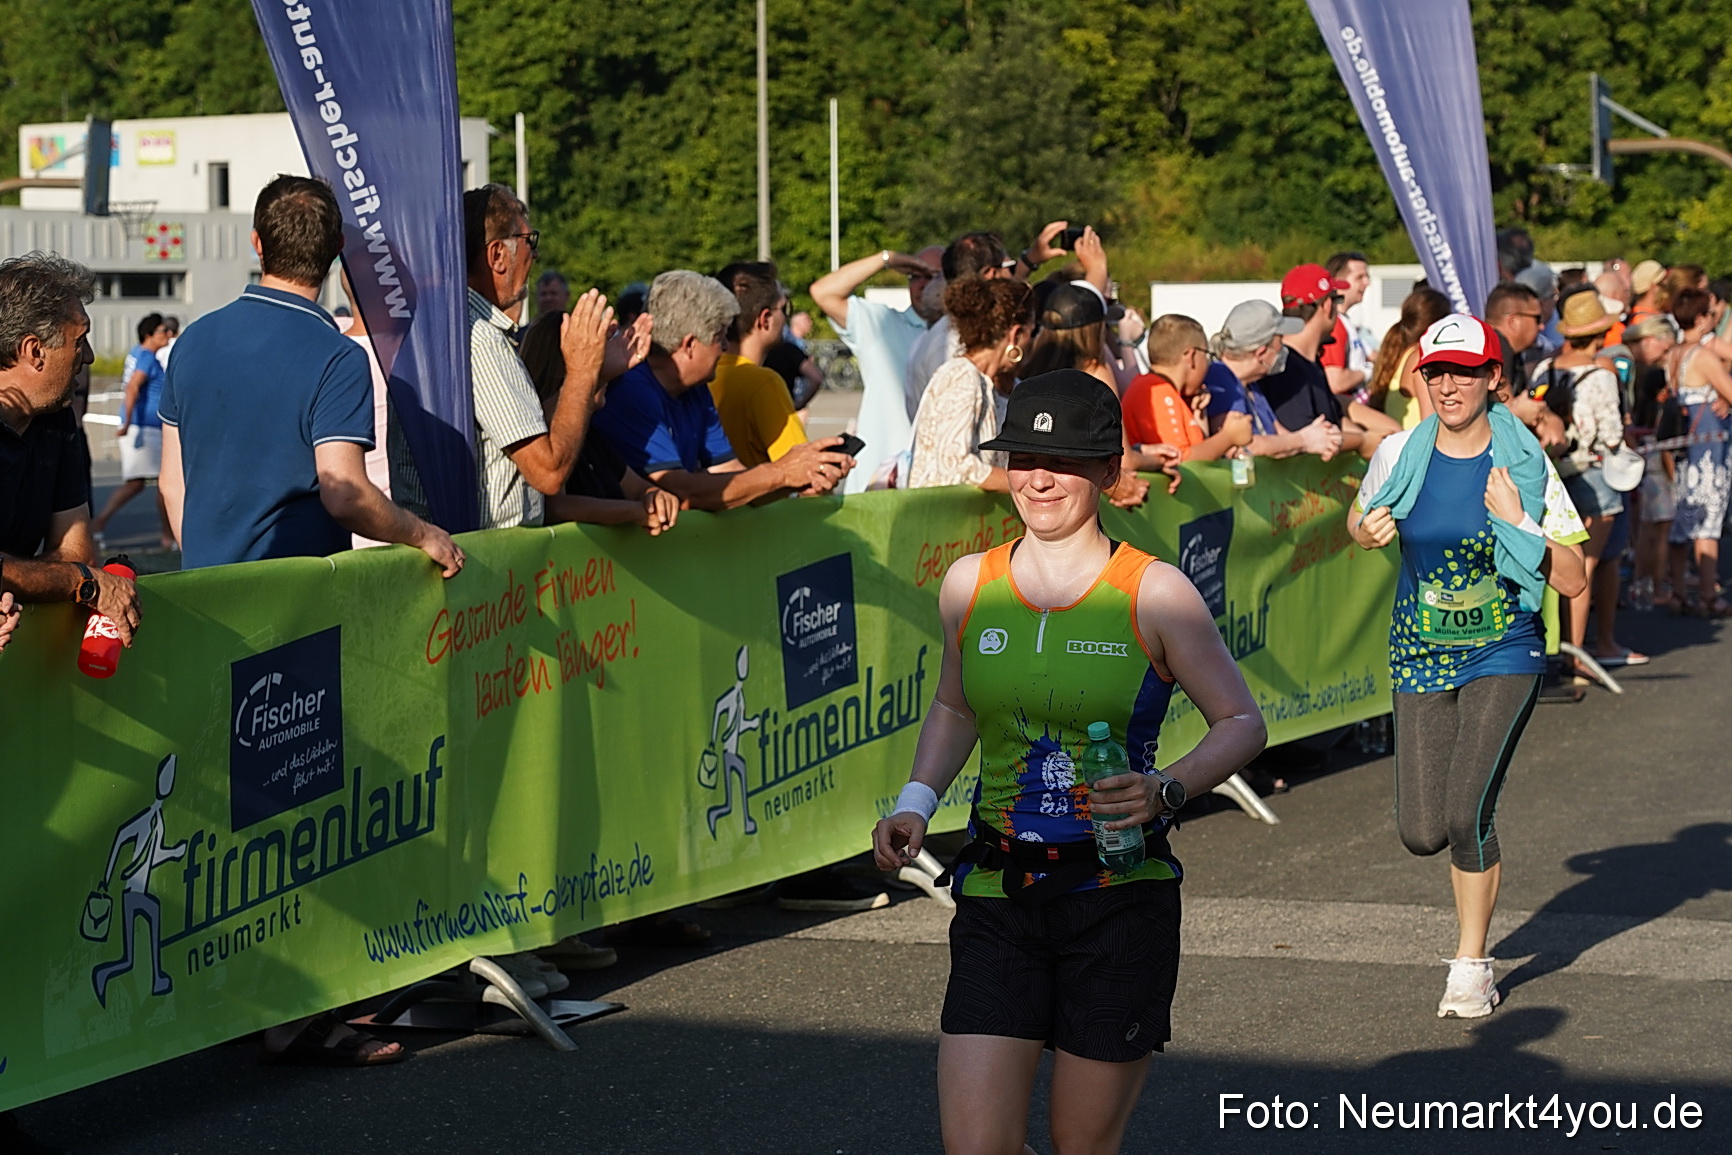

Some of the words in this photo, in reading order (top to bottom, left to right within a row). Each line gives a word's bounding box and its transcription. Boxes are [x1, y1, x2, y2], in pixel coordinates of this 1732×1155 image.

[426, 569, 528, 665] Gesunde
[534, 557, 616, 618] Firmen
[793, 602, 841, 637] Fischer
[1422, 610, 1431, 632] RUN
[1434, 626, 1459, 636] Müller
[1460, 625, 1491, 636] Verena
[1437, 607, 1484, 628] 709
[1491, 601, 1503, 631] 2022
[474, 642, 552, 720] laufen
[556, 598, 639, 690] länger!
[1067, 640, 1128, 657] BOCK
[251, 688, 326, 737] Fischer
[758, 644, 927, 788] firmenlauf
[258, 717, 320, 752] AUTOMOBILE
[764, 764, 835, 821] neumarkt
[183, 735, 446, 936] firmenlauf
[187, 893, 302, 976] neumarkt
